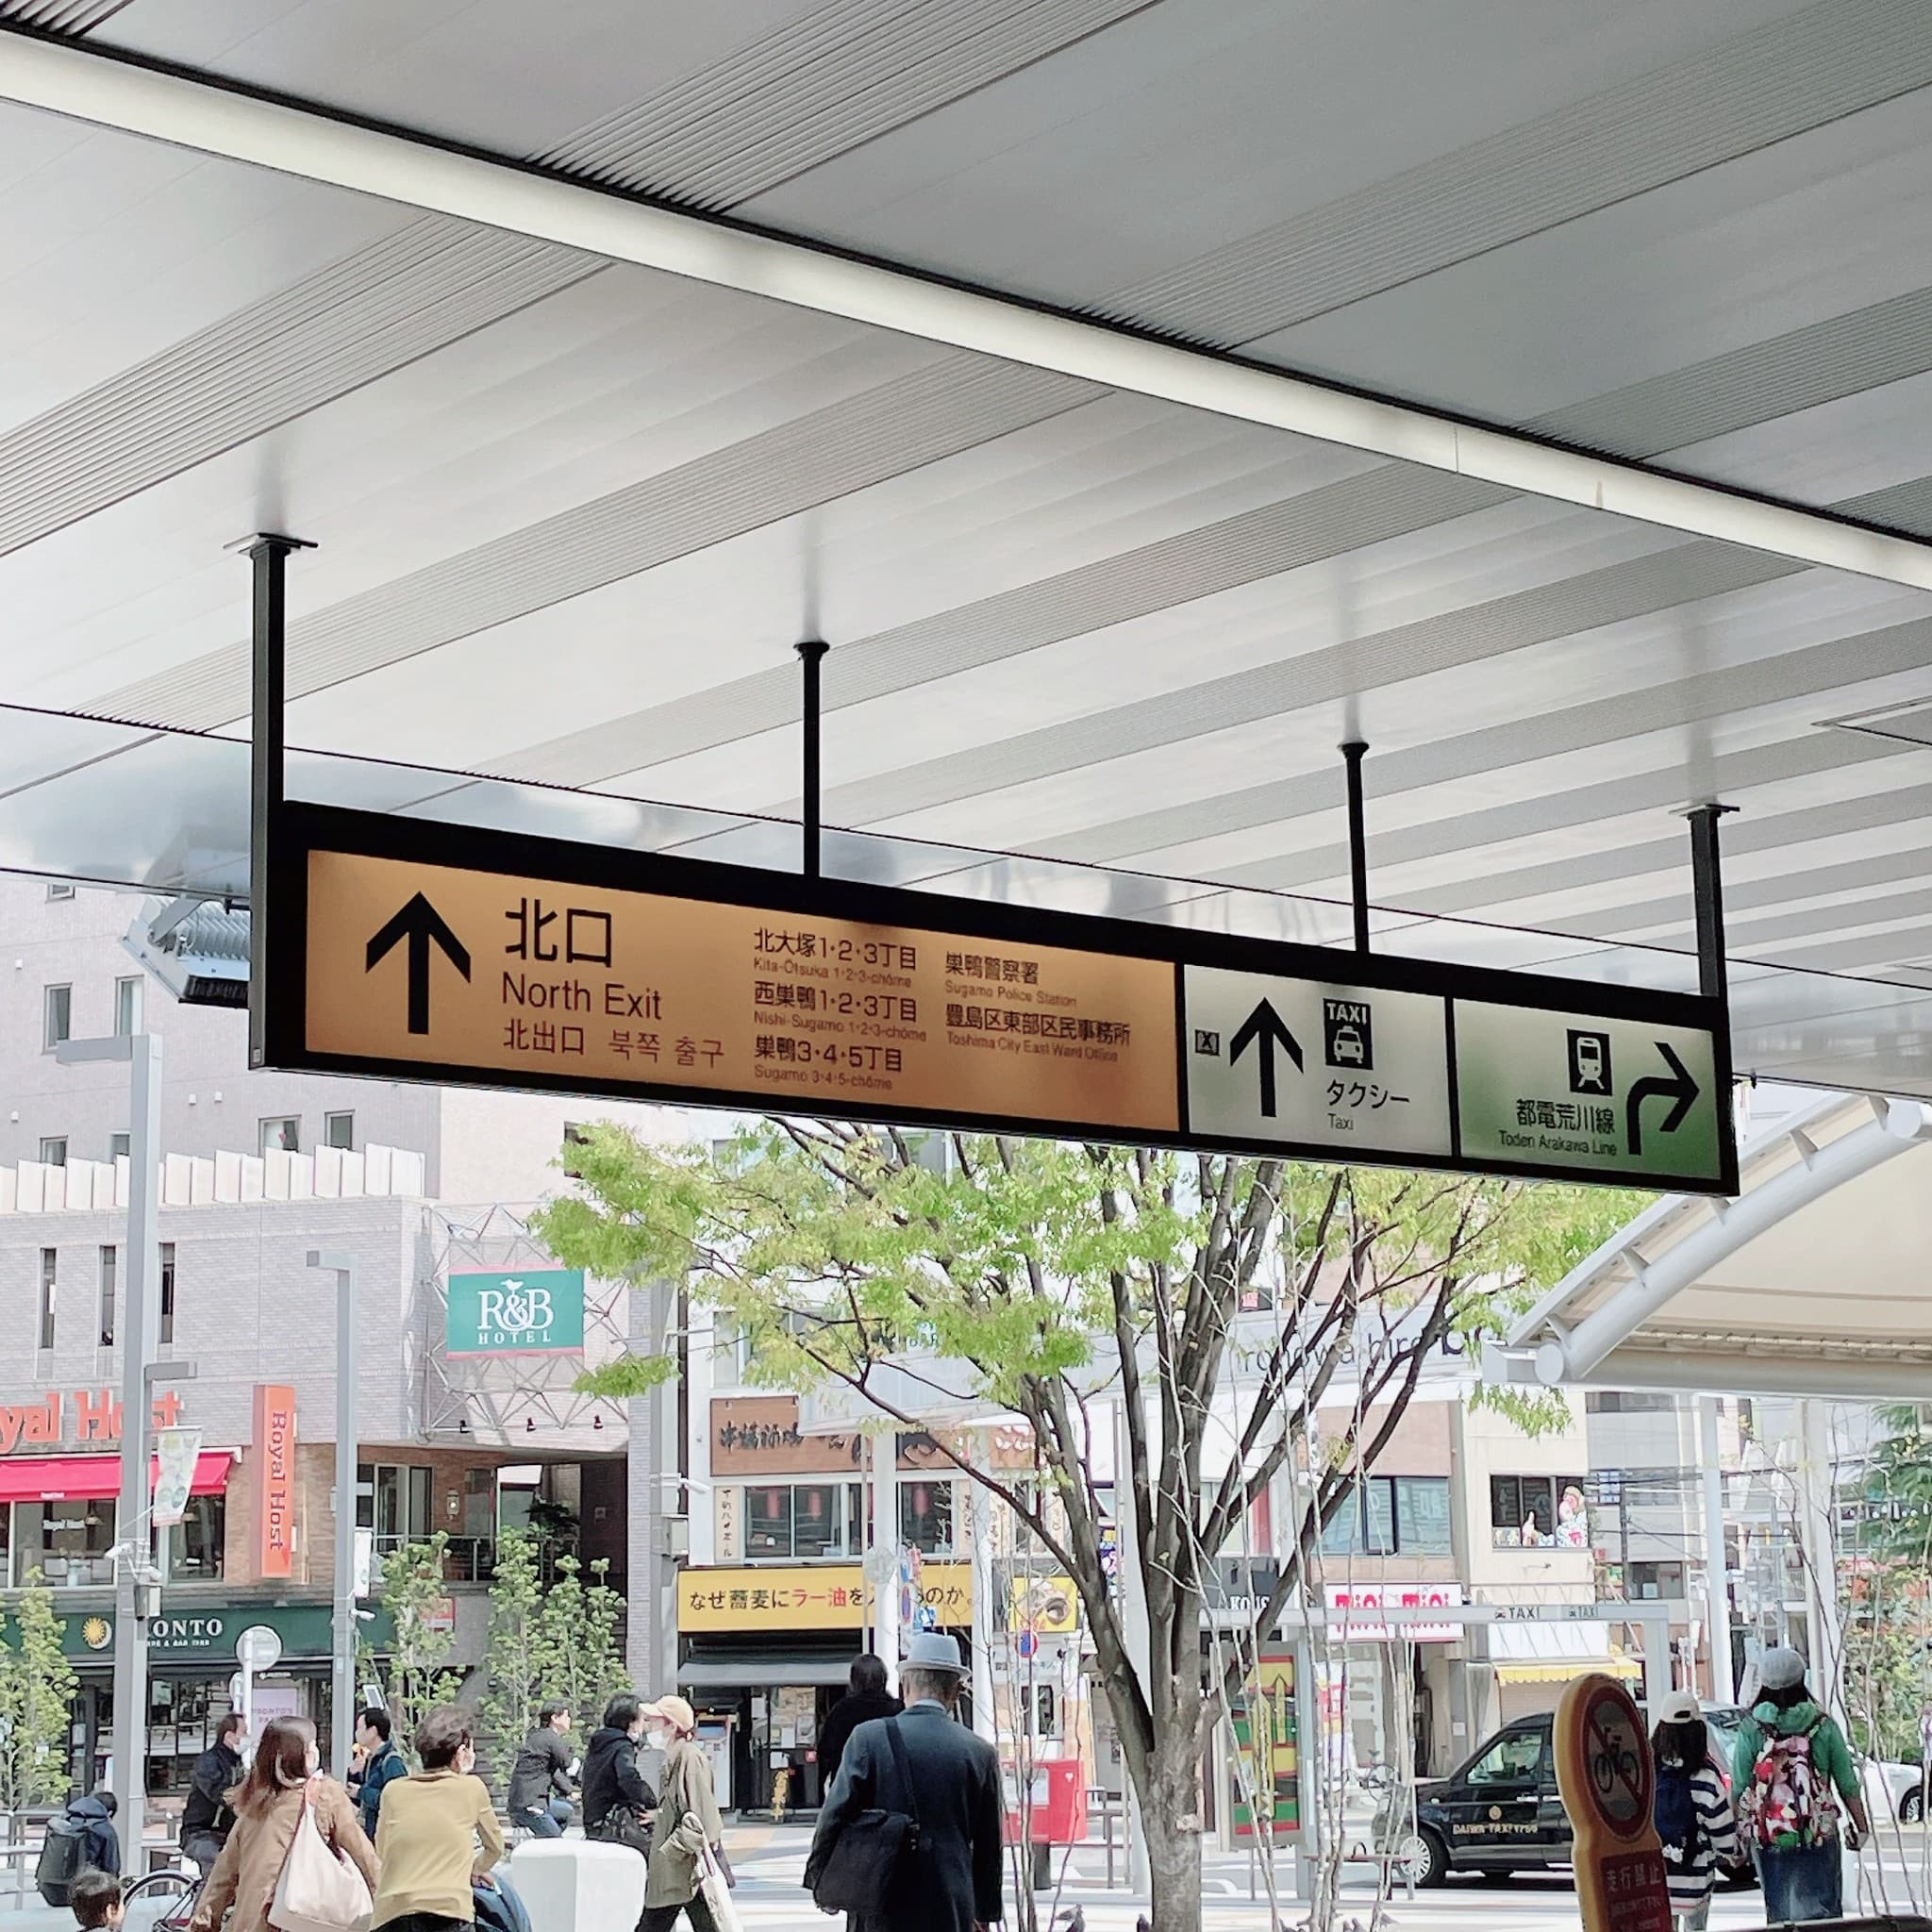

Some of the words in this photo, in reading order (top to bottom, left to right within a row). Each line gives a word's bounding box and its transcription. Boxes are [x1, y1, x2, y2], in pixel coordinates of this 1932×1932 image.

[506, 897, 611, 968] 北口
[945, 951, 1039, 985] 巣鴨警察署
[503, 972, 591, 1012] North
[605, 983, 662, 1020] Exit
[945, 979, 992, 998] Sugamo
[997, 986, 1032, 1003] Police
[1037, 991, 1077, 1008] Station
[946, 1004, 1131, 1047] 豊島区東部区民事務所
[1326, 1003, 1367, 1024] TAXI
[503, 1019, 584, 1056] 北出口
[608, 1029, 660, 1063] 북쪽
[675, 1037, 724, 1069] 출구
[947, 1031, 995, 1049] Toshima
[998, 1038, 1021, 1054] City
[1024, 1040, 1049, 1055] East
[1052, 1042, 1082, 1058] Ward
[1085, 1047, 1118, 1062] Office
[755, 1065, 808, 1082] Sugamo
[1326, 1079, 1409, 1108] タクシー
[1327, 1113, 1354, 1130] Taxi
[1516, 1099, 1615, 1134] 都電荒川線
[1499, 1130, 1535, 1149] Toden
[1539, 1134, 1589, 1154] Arakawa
[1592, 1140, 1617, 1157] Line
[476, 1288, 554, 1331] R&B
[478, 1331, 551, 1344] HOTEL
[268, 1411, 287, 1481] Royal
[270, 1491, 285, 1551] Host
[1509, 1607, 1541, 1619] TAXI
[1578, 1607, 1599, 1618] TAXI
[153, 1619, 223, 1638] ONTO
